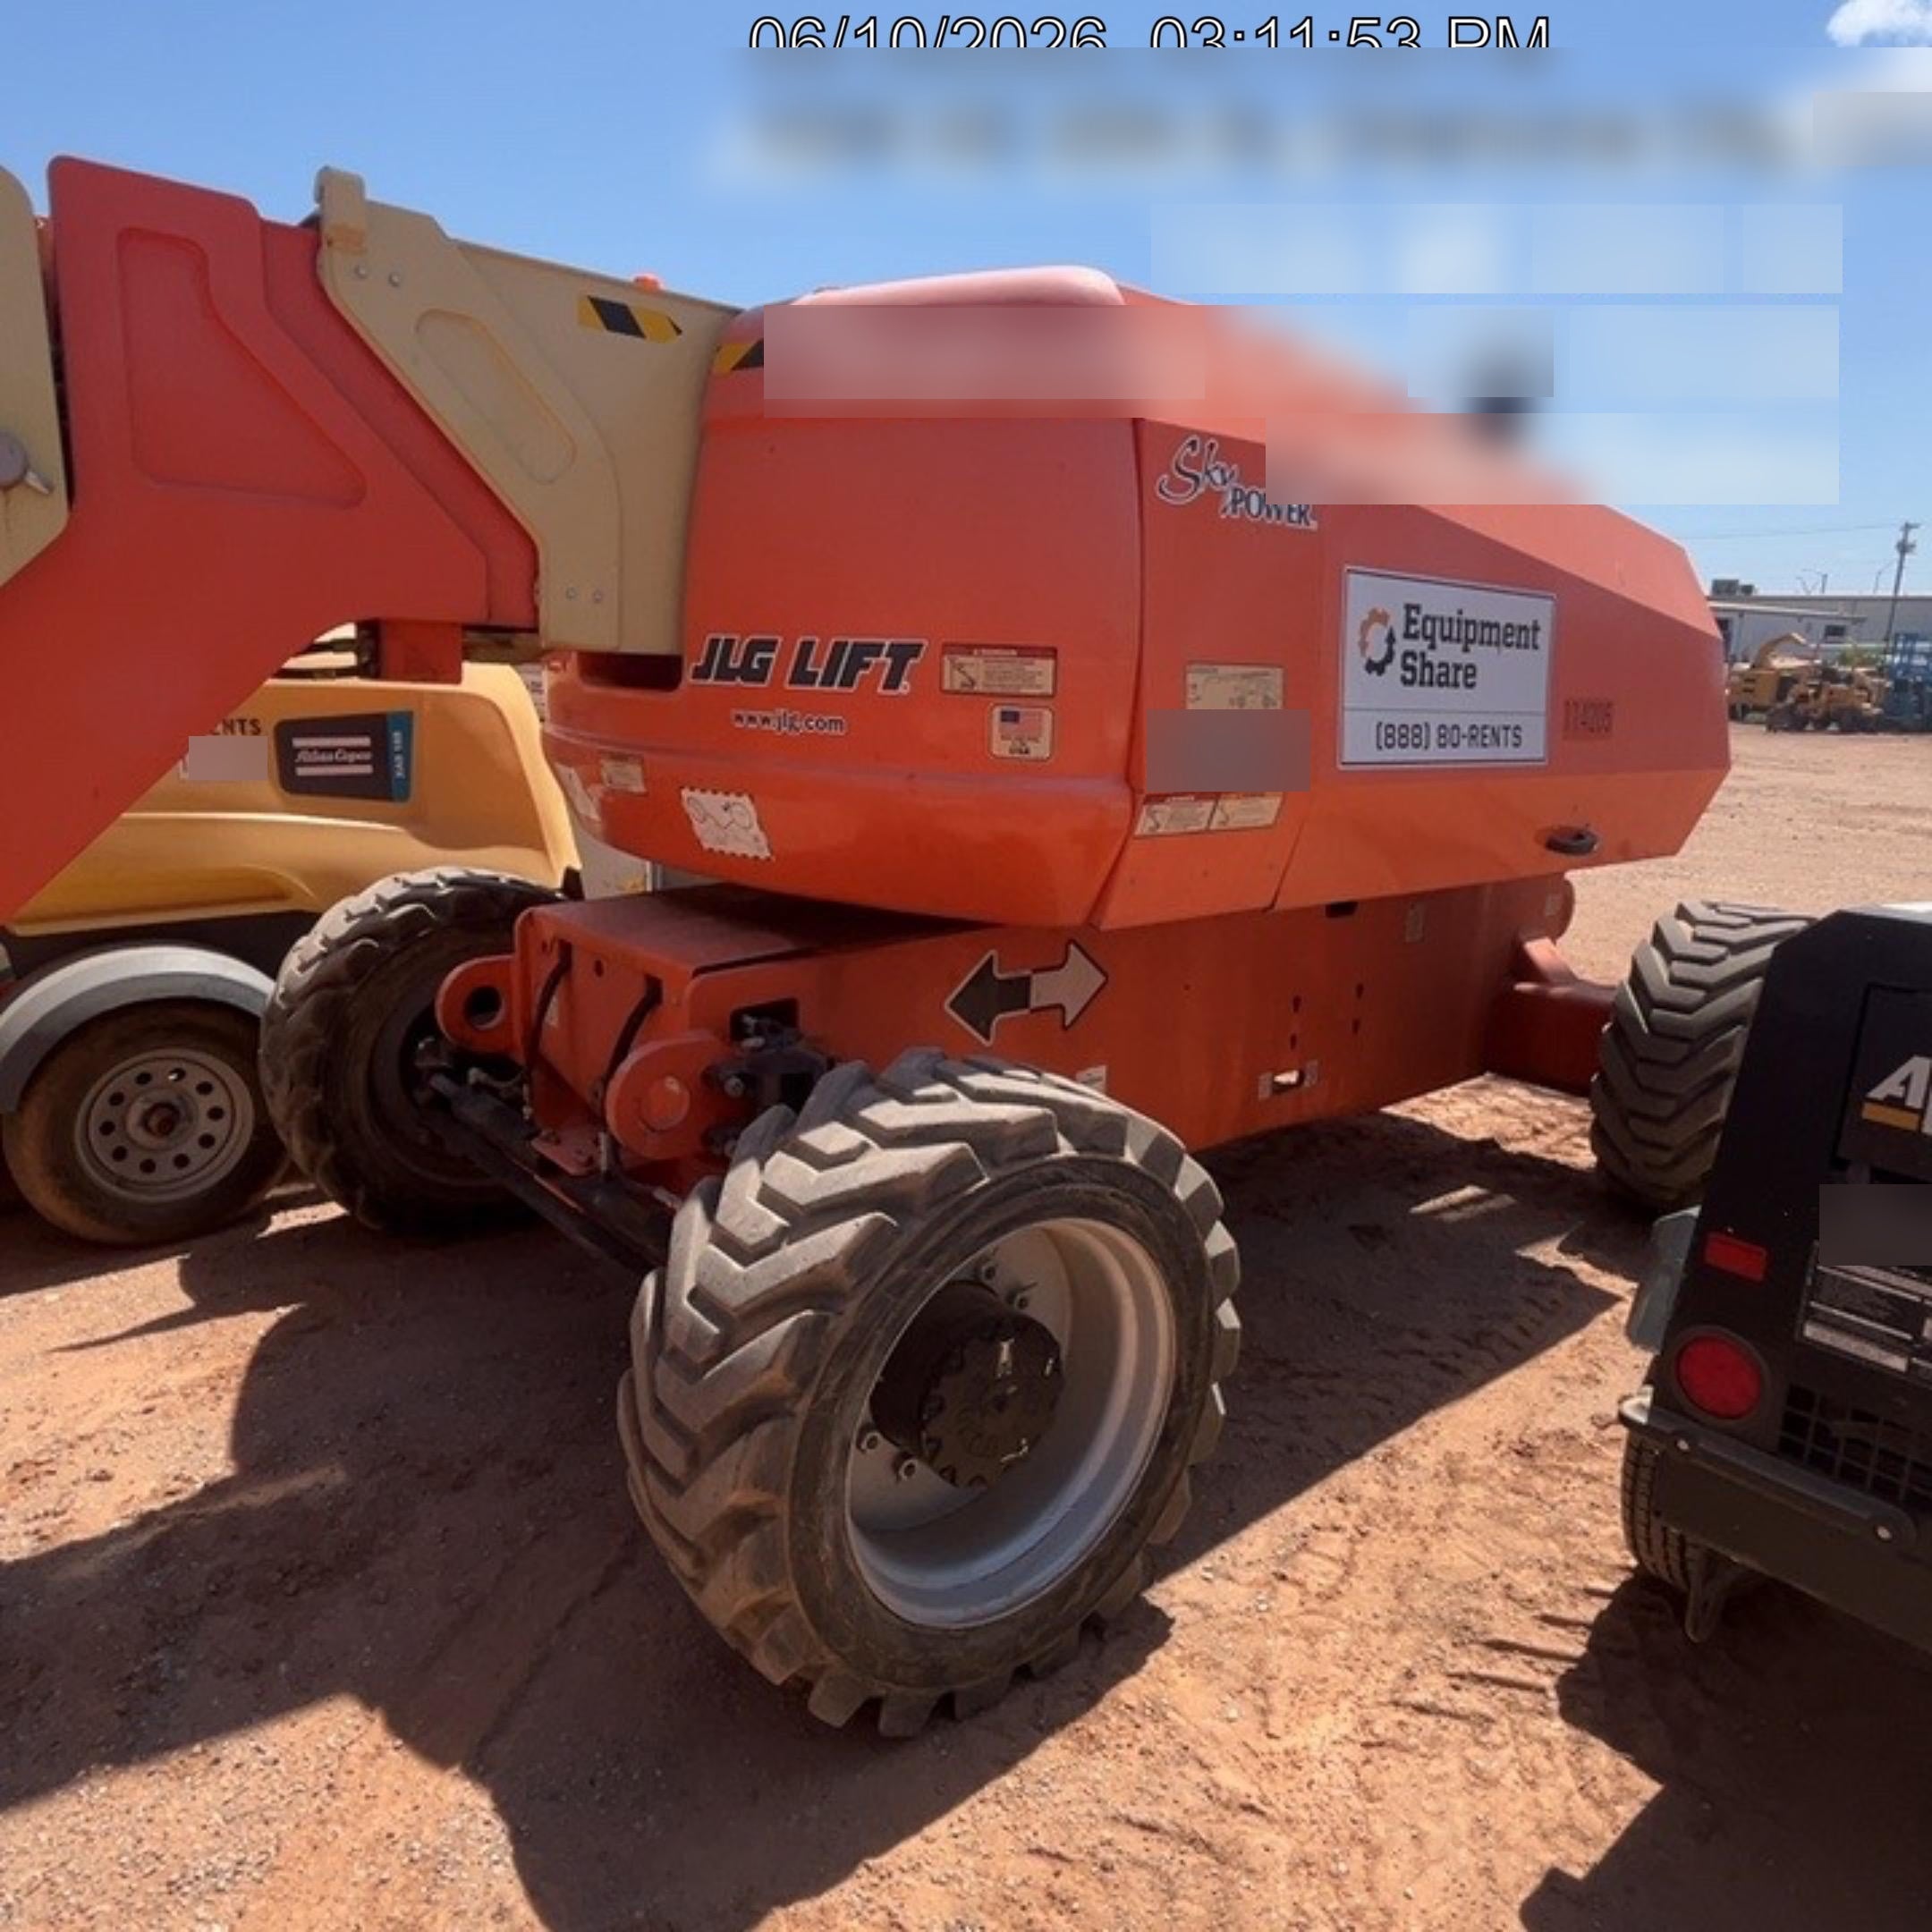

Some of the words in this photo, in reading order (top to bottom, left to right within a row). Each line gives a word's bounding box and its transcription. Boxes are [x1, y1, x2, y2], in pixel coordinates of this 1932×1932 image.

[1157, 435, 1239, 506] Sky
[1403, 604, 1540, 652] Equipment
[691, 636, 779, 683] JLG
[787, 638, 926, 691] LIFT
[1401, 651, 1476, 689] Share
[213, 718, 261, 735] NTS
[733, 709, 845, 733] www.jlg.com
[1376, 722, 1429, 750] (888)
[1437, 724, 1522, 749] 80-RENTS
